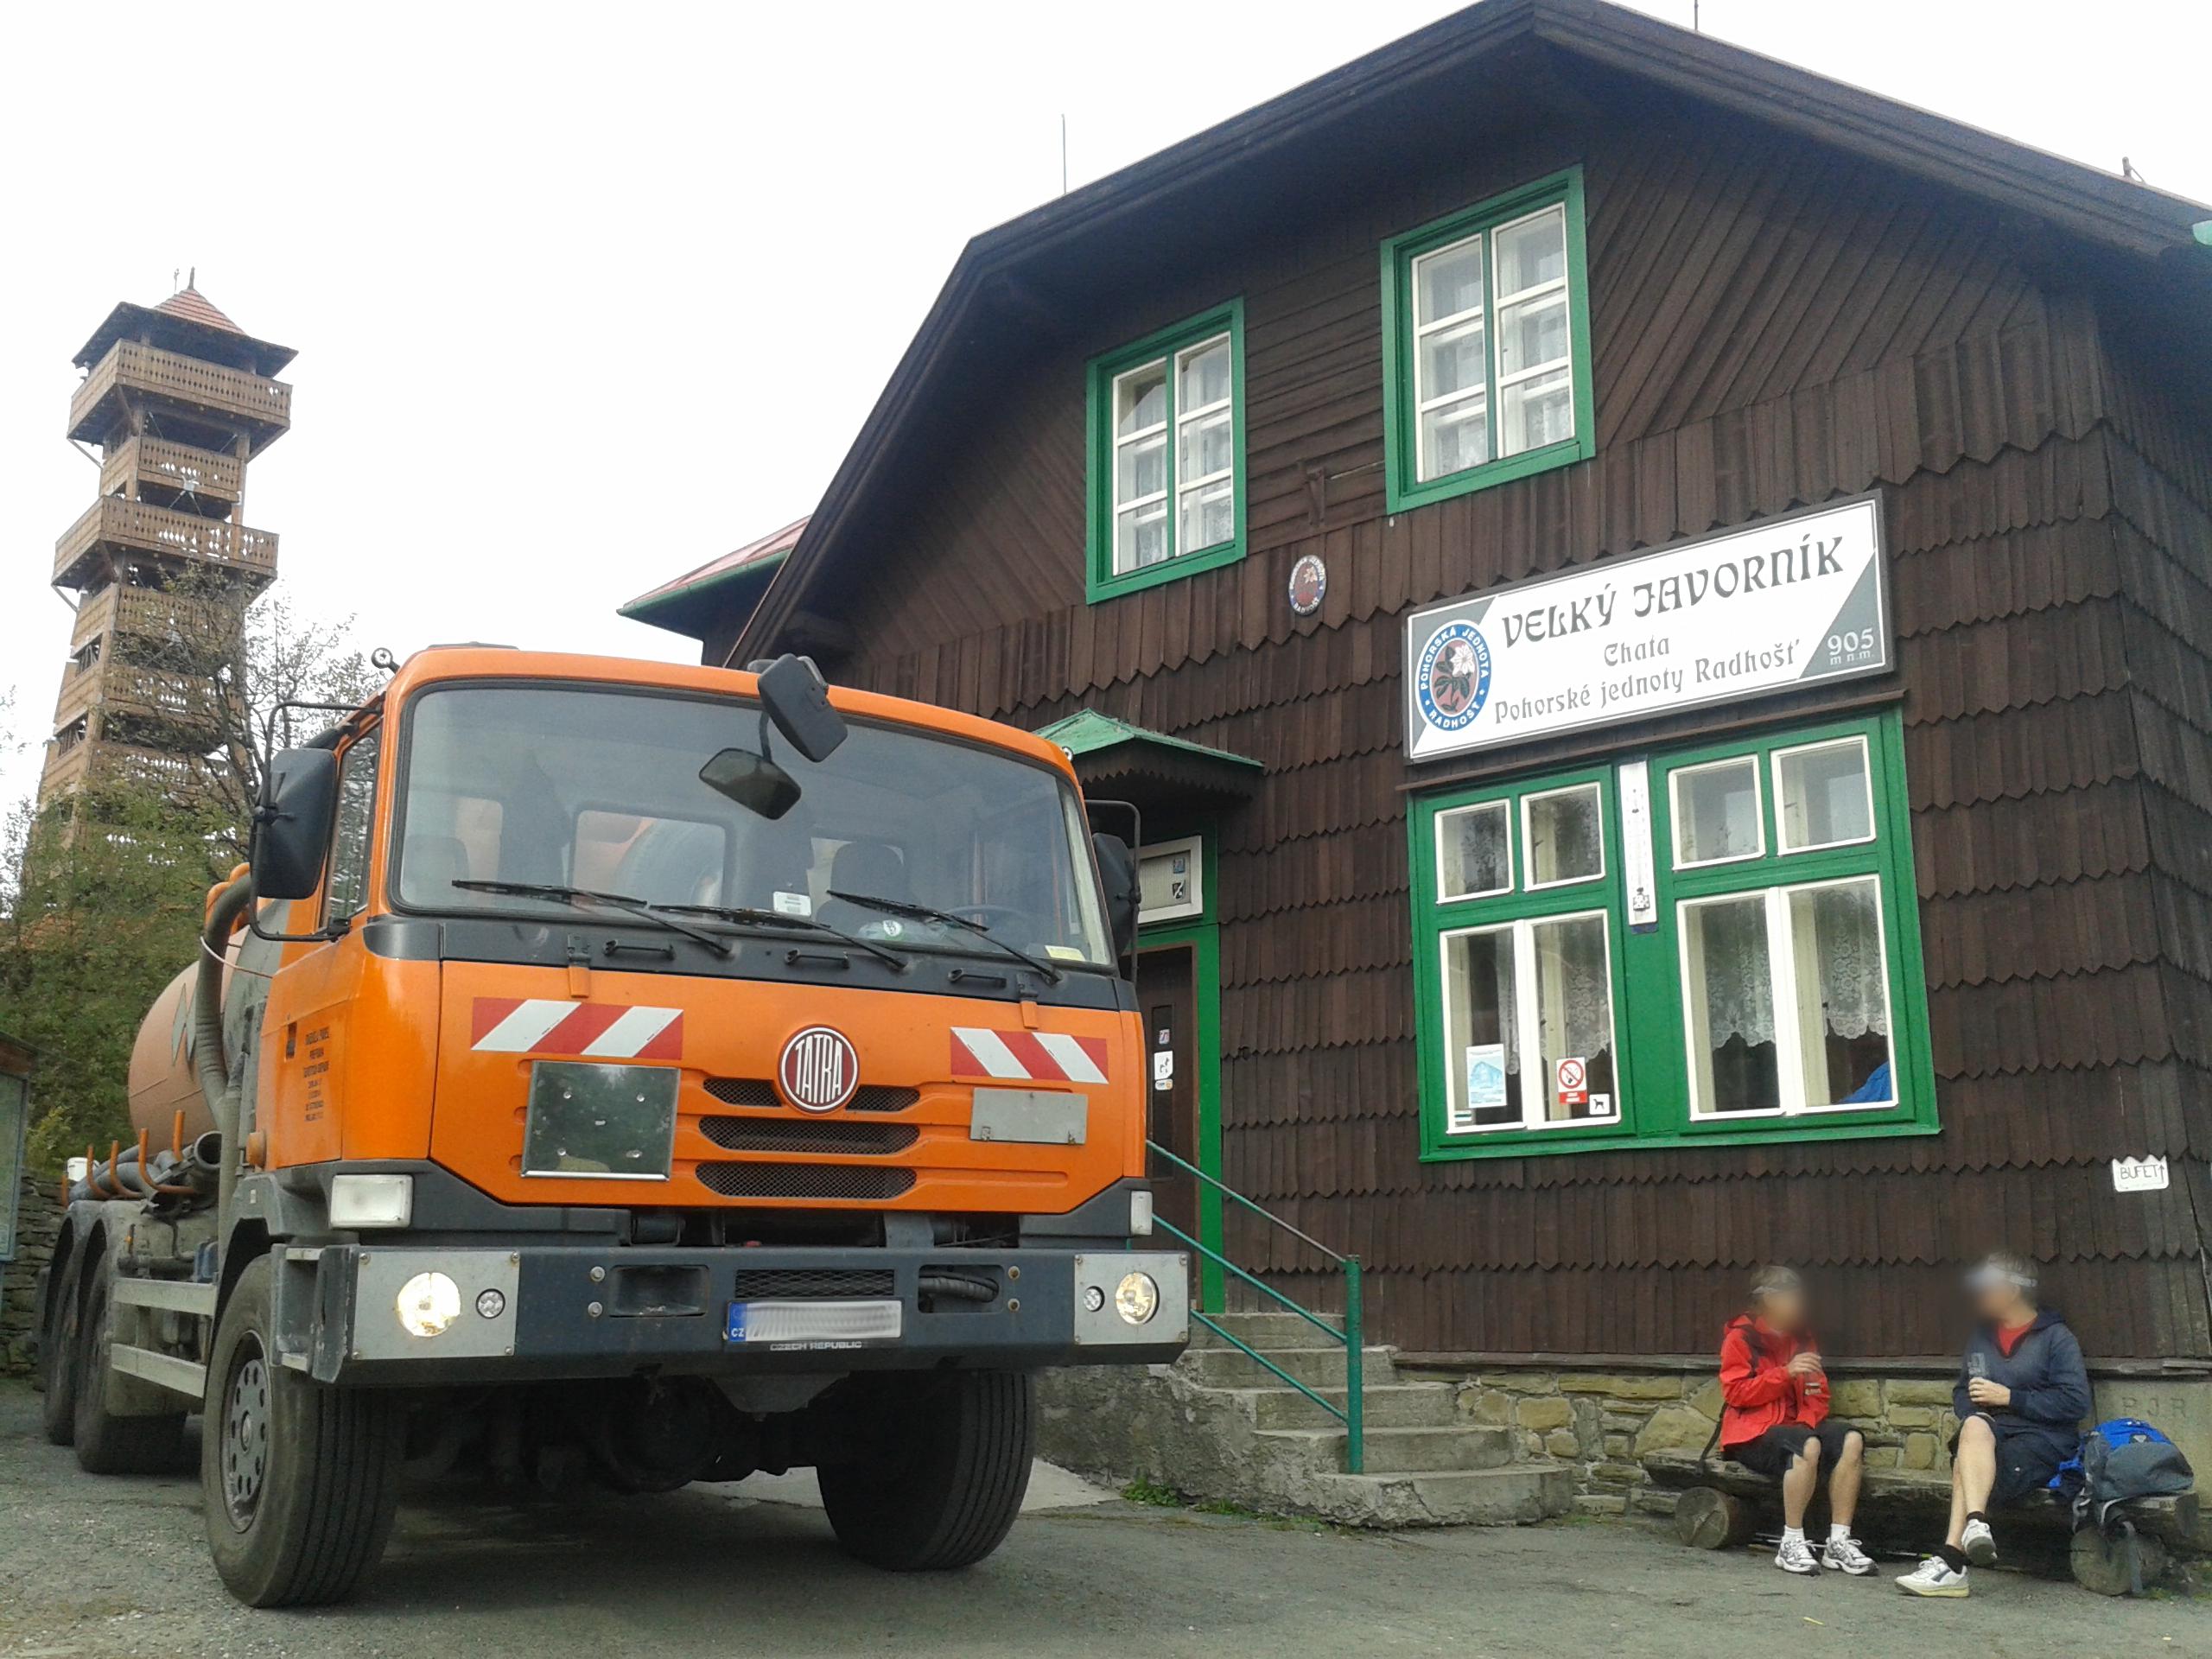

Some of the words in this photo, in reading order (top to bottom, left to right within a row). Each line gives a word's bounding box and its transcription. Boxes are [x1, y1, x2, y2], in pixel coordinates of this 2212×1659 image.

[1633, 533, 1843, 617] JAVORNÍK
[1461, 628, 1490, 677] JEDNOTA
[1604, 635, 1669, 666] Chata
[1827, 627, 1874, 656] 905
[1495, 684, 1591, 724] Pohorské
[1600, 667, 1683, 709] jednoty
[1694, 639, 1800, 683] Radhošť
[795, 1033, 842, 1104] TATRA
[2120, 1164, 2158, 1180] BUFET
[731, 1327, 745, 1338] CZ
[770, 1343, 806, 1351] CZECH
[810, 1340, 862, 1351] REPUBLIC
